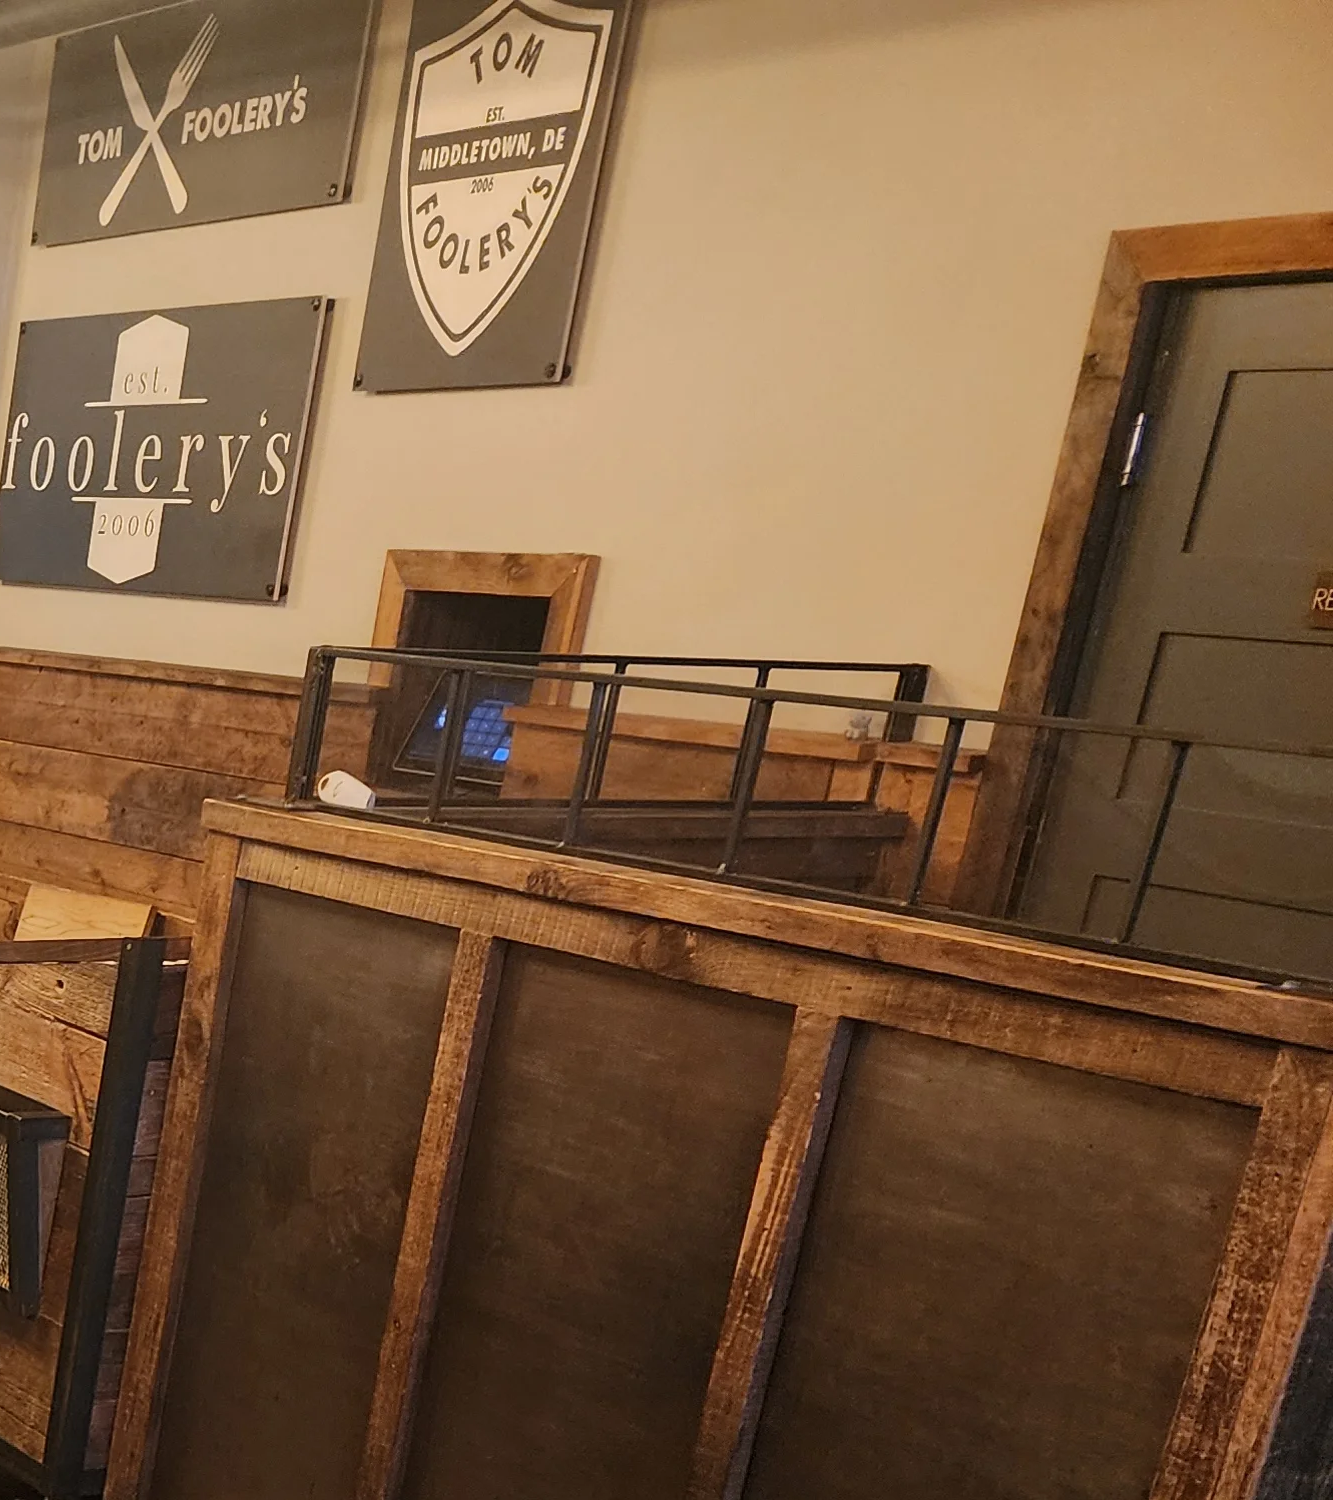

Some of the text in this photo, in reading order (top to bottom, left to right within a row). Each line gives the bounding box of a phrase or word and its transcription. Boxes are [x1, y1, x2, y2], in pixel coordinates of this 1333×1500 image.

[470, 32, 545, 84] TOM
[77, 74, 308, 165] TOM FOOLERY'S
[486, 106, 506, 123] EST.
[418, 126, 567, 171] MIDDLETOWN, DE
[470, 177, 494, 194] 2006
[416, 175, 553, 275] FOOLERY'S
[123, 366, 169, 394] est.
[1, 408, 292, 513] foolery's
[97, 509, 155, 536] 2006
